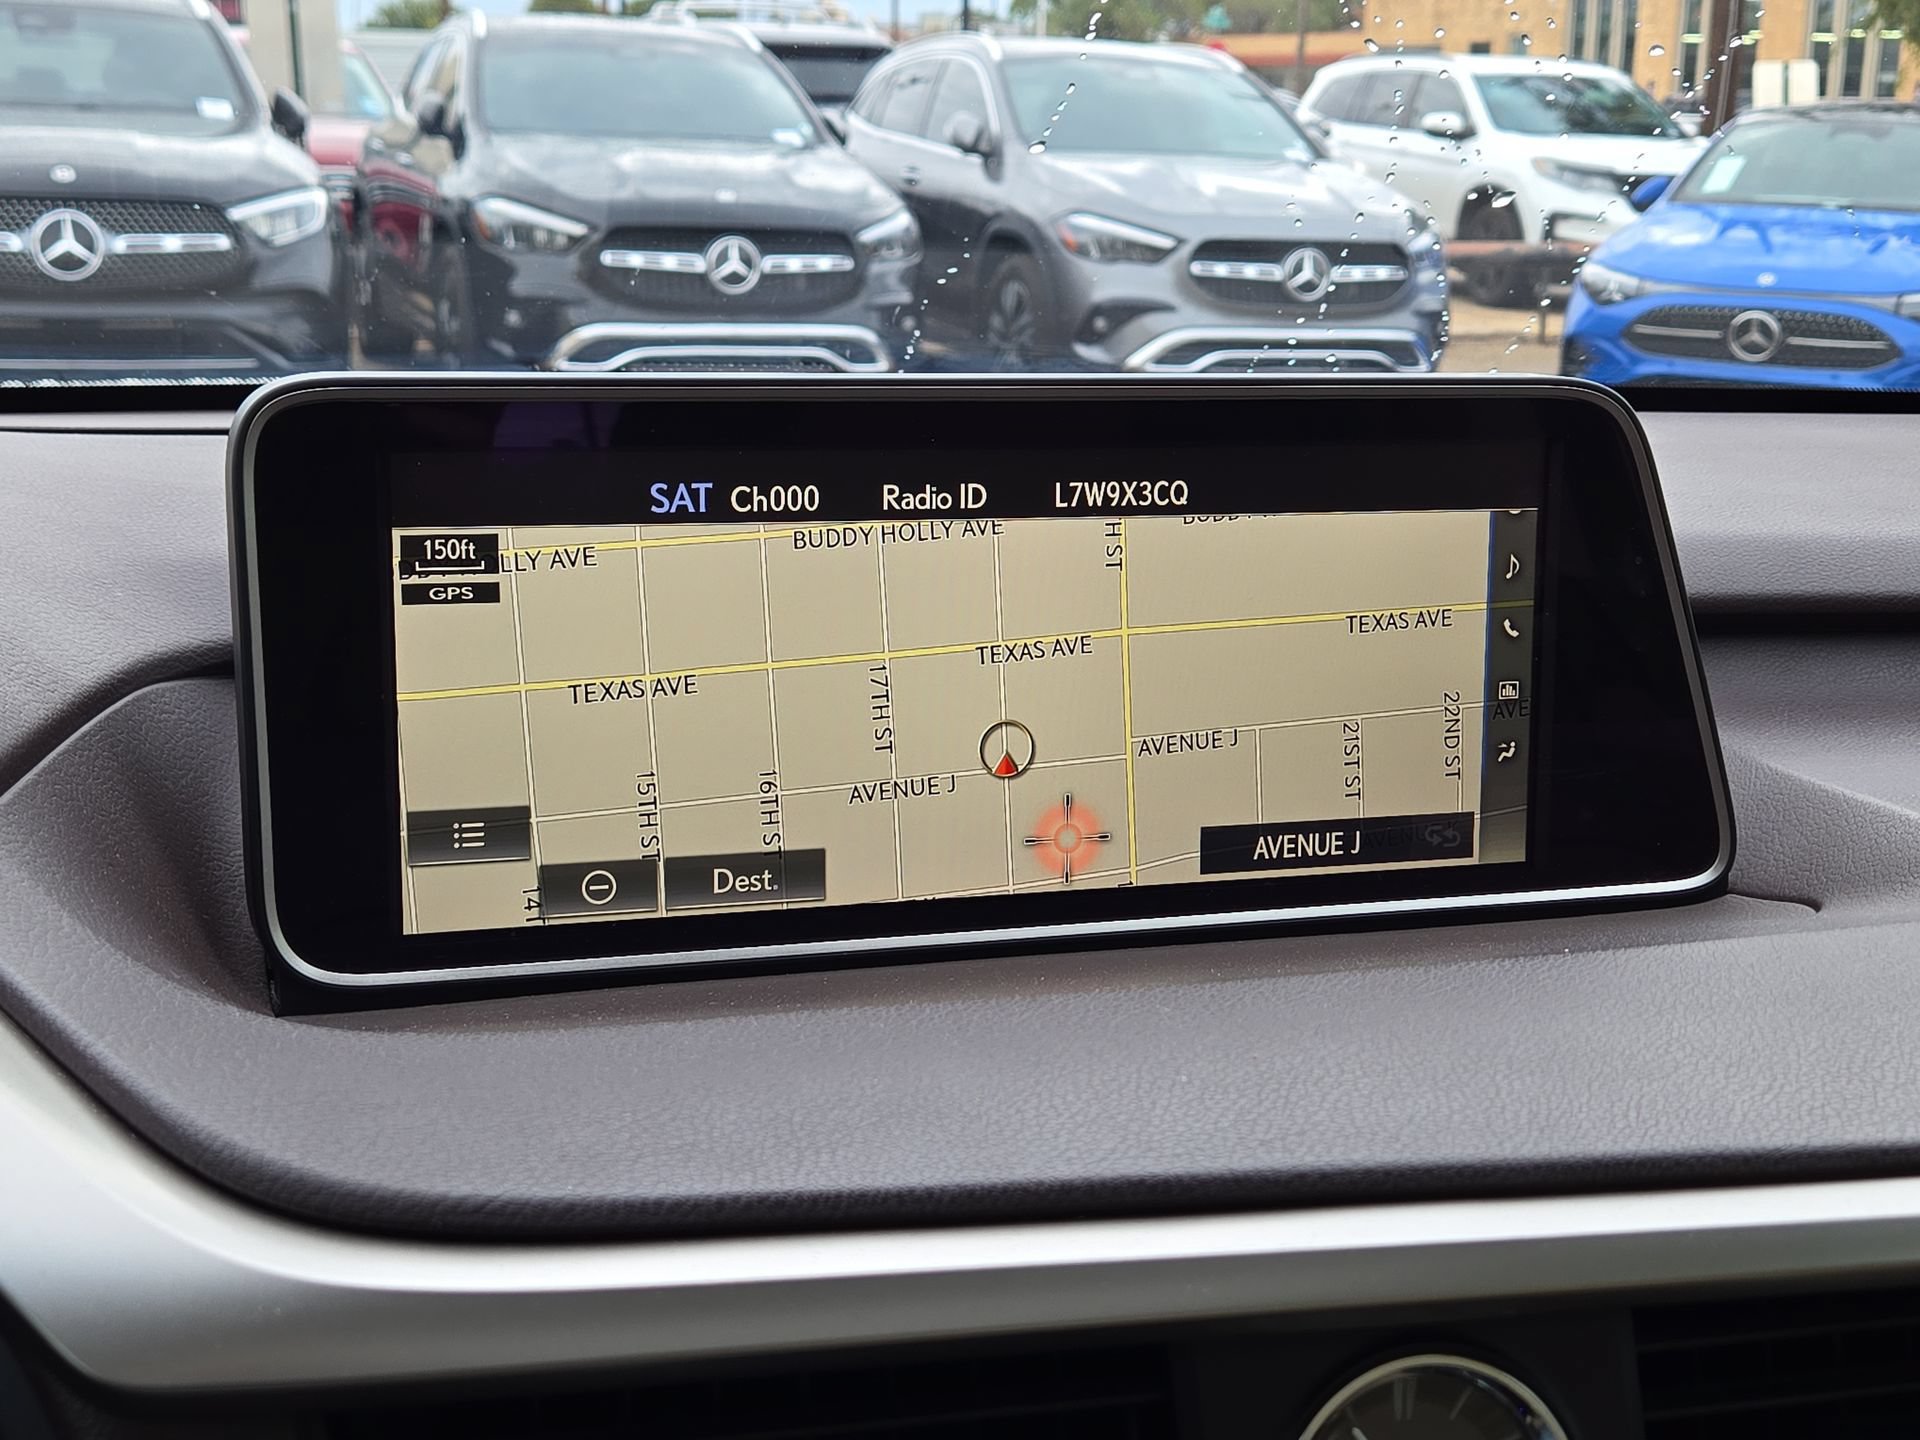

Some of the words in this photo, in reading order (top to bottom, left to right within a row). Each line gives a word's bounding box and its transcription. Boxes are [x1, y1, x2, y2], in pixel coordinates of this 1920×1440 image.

[650, 482, 713, 514] SAT
[731, 485, 820, 512] Ch000
[883, 483, 953, 511] Radio
[960, 483, 987, 509] ID
[1055, 480, 1189, 508] L7W9X3CQ
[793, 525, 874, 549] BUDDY
[881, 521, 953, 544] HOLLY
[961, 520, 1004, 538] AVE
[423, 538, 476, 560] 150ft
[550, 546, 597, 570] AVE
[1105, 544, 1123, 571] ST
[428, 586, 474, 600] GPS
[1345, 612, 1409, 634] TEXAS
[1414, 609, 1452, 629] AVE
[976, 640, 1046, 665] TEXAS
[1051, 635, 1093, 658] AVE
[567, 679, 645, 705] TEXAS
[651, 675, 698, 699] AVE
[869, 664, 891, 722] 17TH
[1443, 691, 1461, 749] 22ND
[873, 727, 894, 754] ST
[1138, 730, 1224, 757] AVENUE
[1229, 729, 1238, 747] J
[1342, 720, 1361, 769] 21ST
[1444, 754, 1461, 780] ST
[636, 770, 659, 829] 15TH
[759, 769, 780, 825] 16TH
[848, 776, 941, 804] AVENUE
[947, 774, 957, 793] J
[1344, 775, 1361, 801] ST
[640, 834, 661, 862] ST
[763, 833, 781, 859] ST
[1253, 832, 1345, 860] AVENUE
[1351, 831, 1361, 854] J
[713, 868, 778, 894] Dest.
